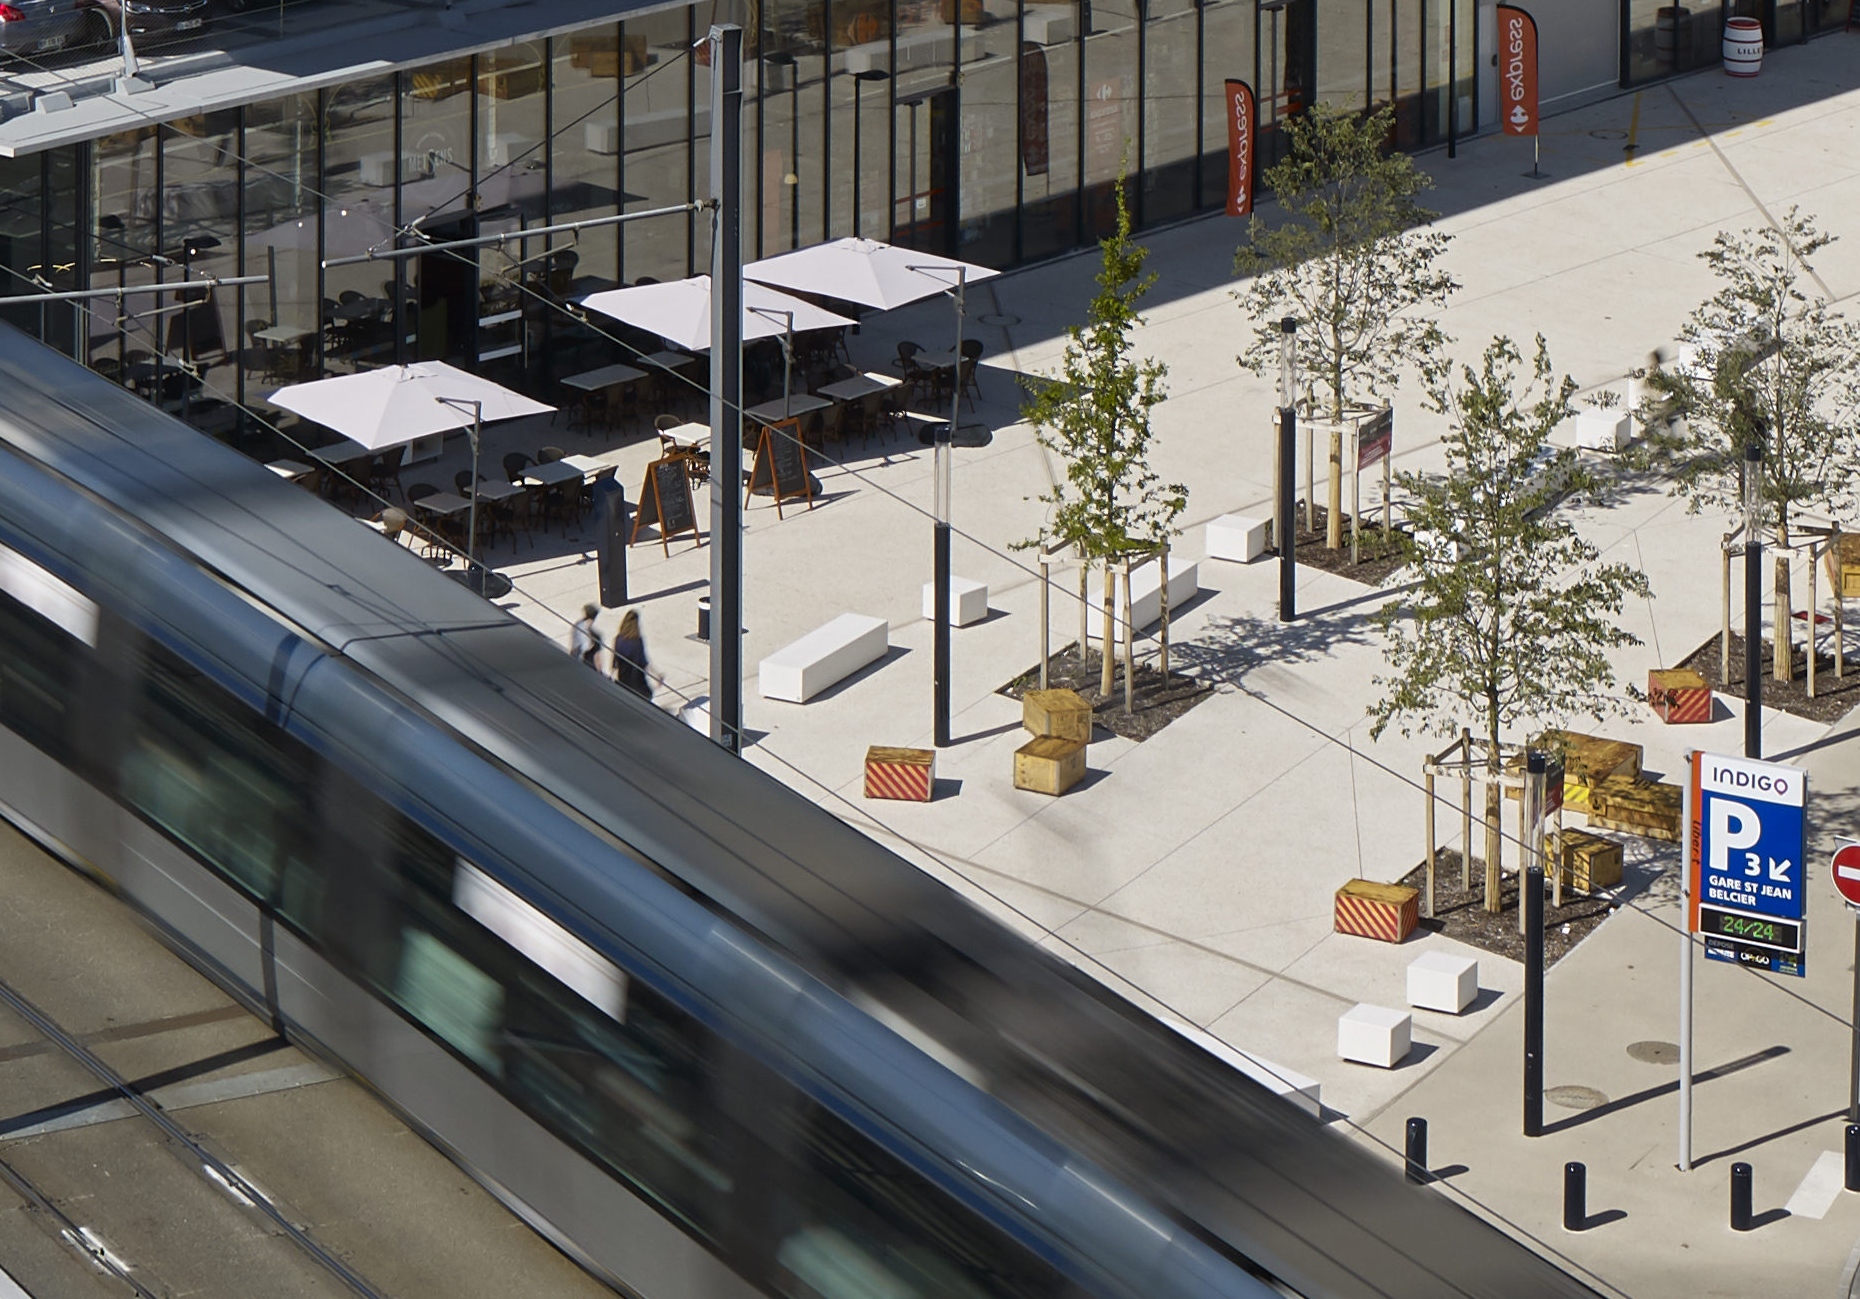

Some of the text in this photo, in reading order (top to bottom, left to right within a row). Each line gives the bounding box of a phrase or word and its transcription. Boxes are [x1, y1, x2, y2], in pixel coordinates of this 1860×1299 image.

[1712, 766, 1789, 796] INDIGO
[1709, 796, 1761, 876] P 3
[1709, 874, 1792, 900] GARE ST JEAN
[1709, 888, 1756, 906] BELCIER
[1723, 915, 1774, 940] 24/24
